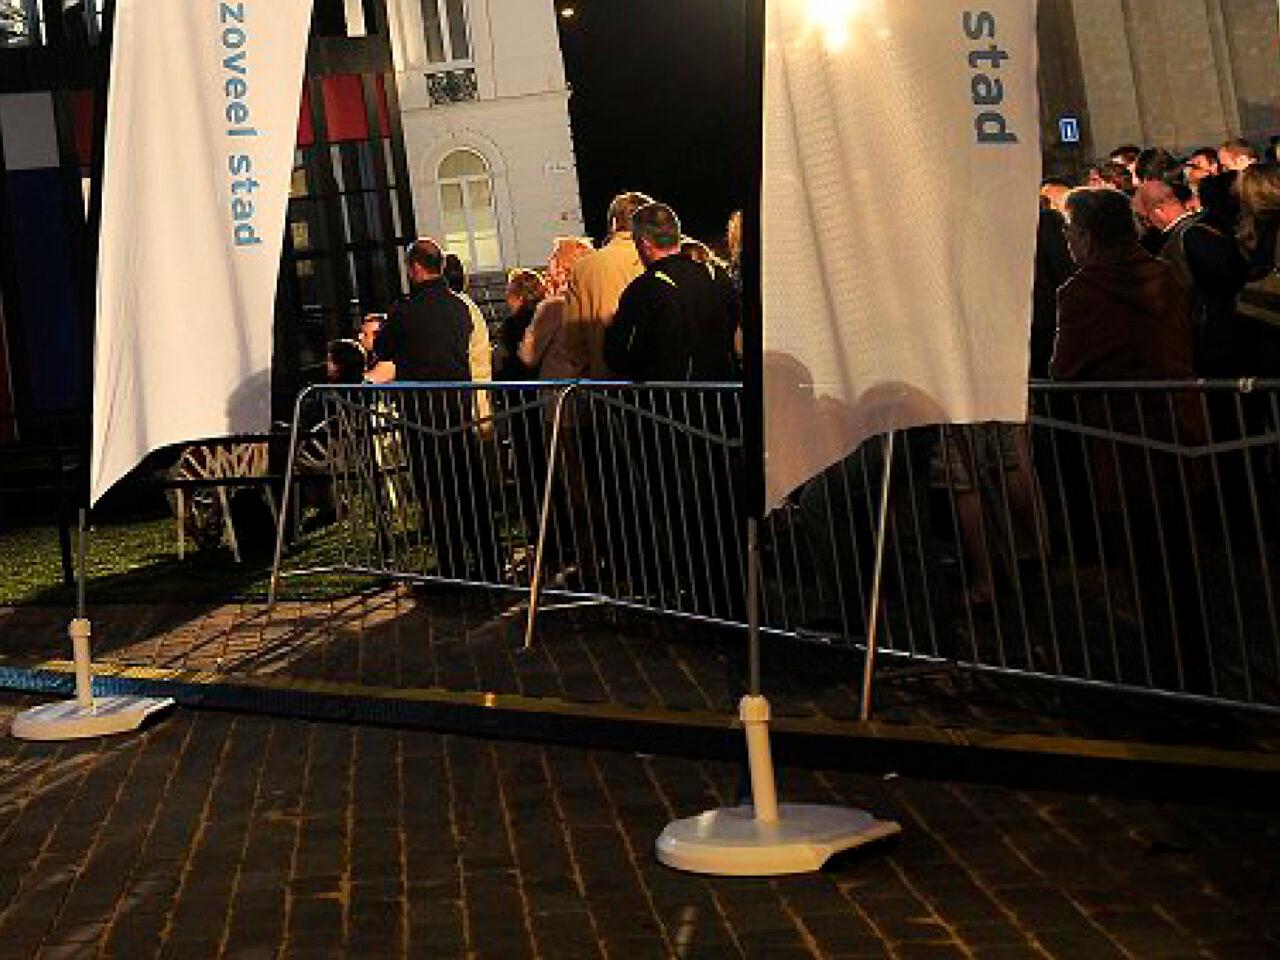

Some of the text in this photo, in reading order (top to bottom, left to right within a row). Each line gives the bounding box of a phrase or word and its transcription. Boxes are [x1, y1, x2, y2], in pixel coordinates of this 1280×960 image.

[219, 2, 261, 247] zoveel stad
[963, 11, 1019, 146] stad
